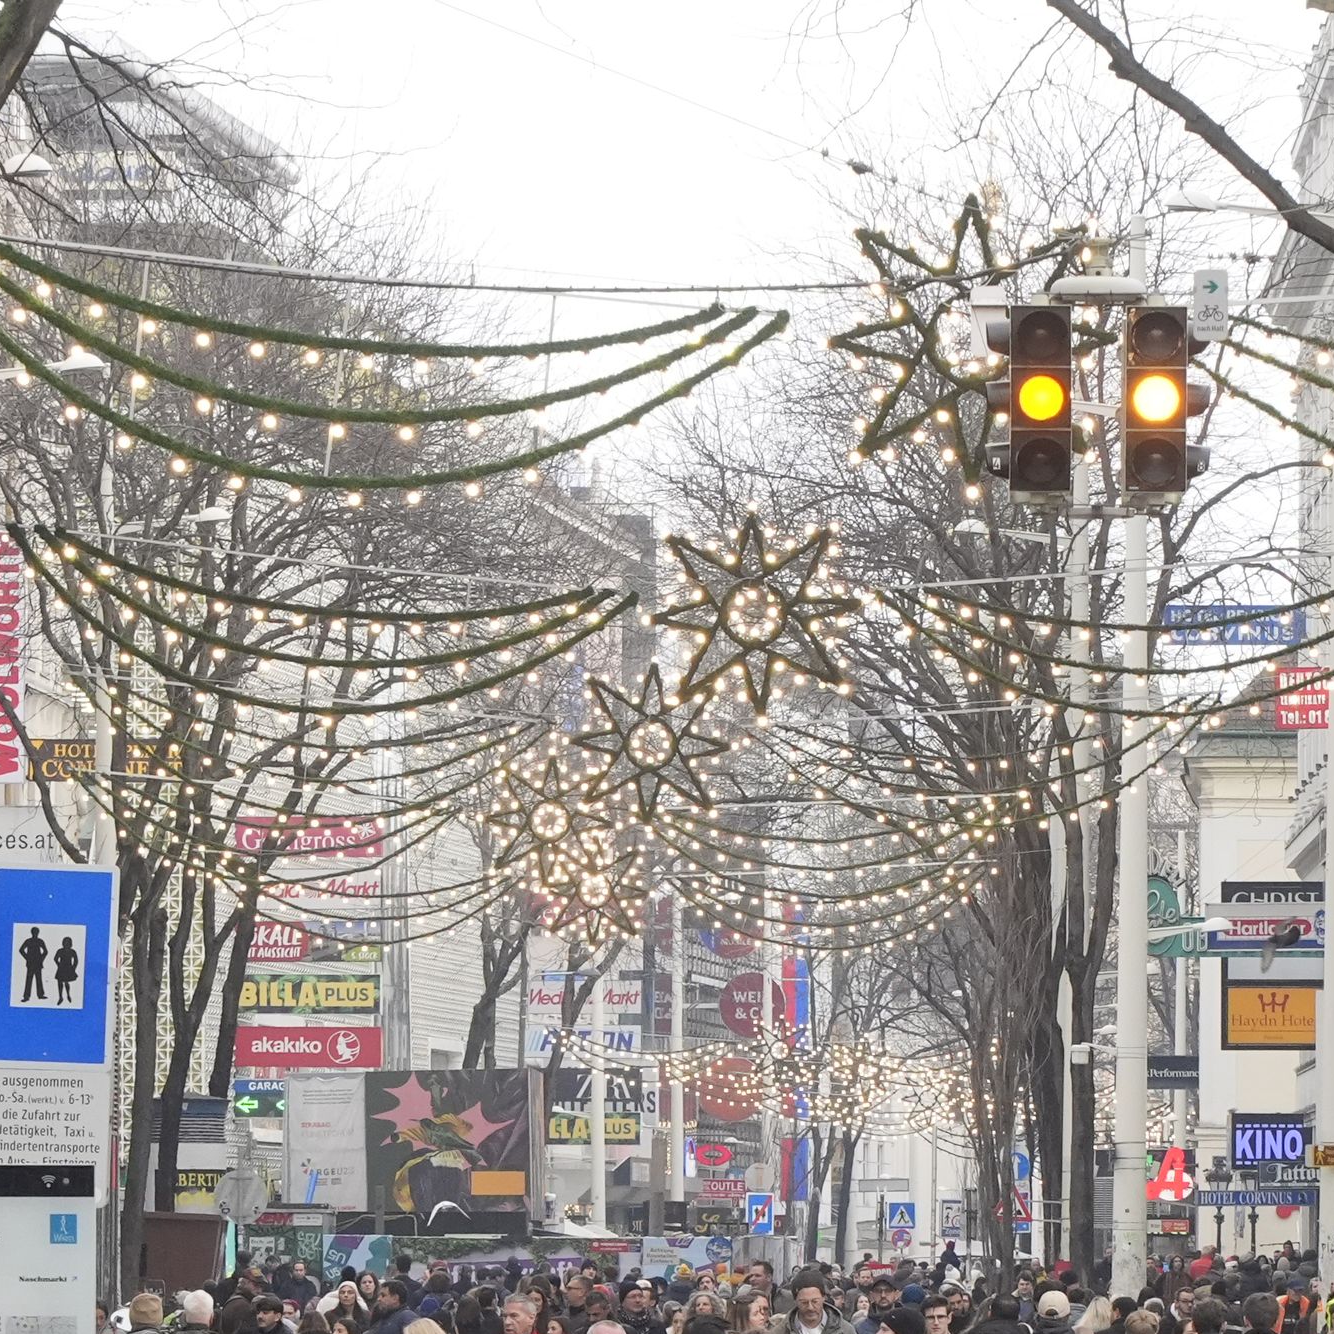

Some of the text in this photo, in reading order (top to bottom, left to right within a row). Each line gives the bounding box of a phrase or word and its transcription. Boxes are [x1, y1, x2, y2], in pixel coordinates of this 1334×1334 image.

[238, 981, 369, 1007] BILLA PLUS
[1231, 1014, 1315, 1029] Haydn Hote
[251, 1036, 322, 1054] akakiko
[2, 1076, 84, 1089] ausgenommen
[2, 1109, 82, 1122] die Zufahrt zur
[64, 1126, 86, 1138] Taxi
[1235, 1129, 1304, 1160] KINO
[1200, 1191, 1292, 1205] HOTEL CORVINUS
[18, 1274, 68, 1283] Naschmarkt
